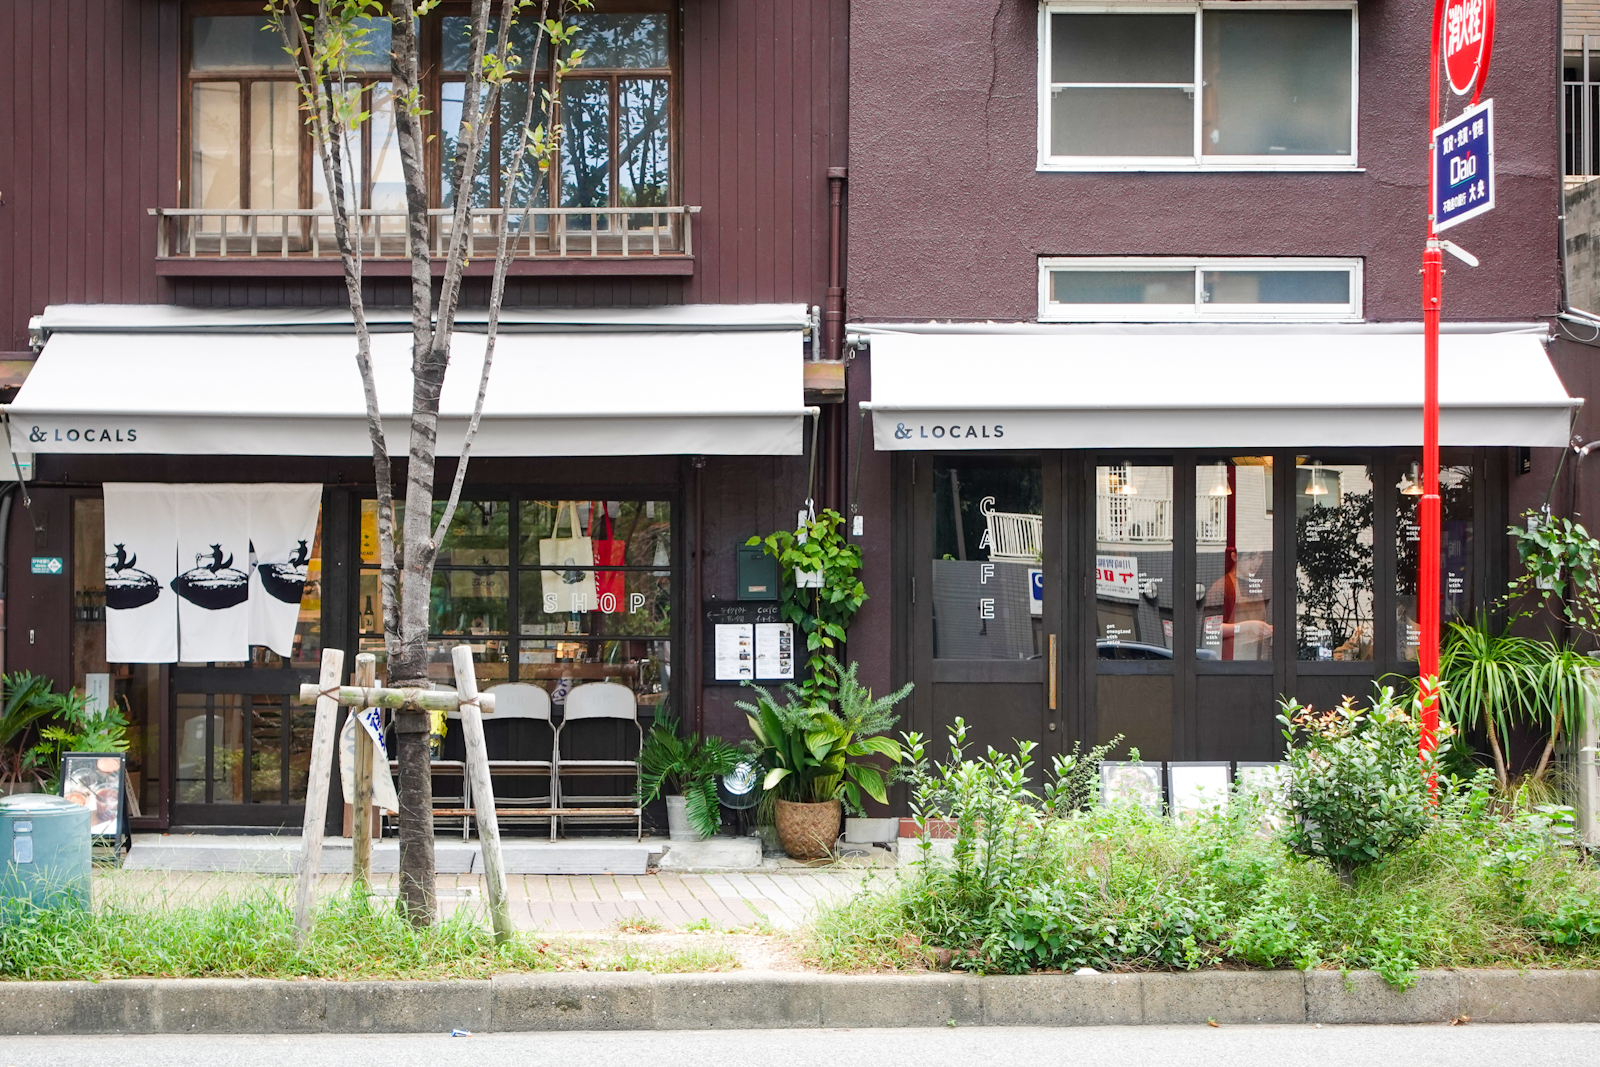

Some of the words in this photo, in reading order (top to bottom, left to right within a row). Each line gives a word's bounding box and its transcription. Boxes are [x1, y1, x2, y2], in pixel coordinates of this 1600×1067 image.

[1448, 0, 1482, 57] 消火栓
[1450, 151, 1477, 186] Daio
[29, 425, 47, 443] &
[55, 429, 137, 442] LOCALS
[894, 422, 913, 440] &
[920, 425, 1004, 439] LOCALS
[979, 496, 995, 619] CAFE
[543, 592, 646, 614] SHOP
